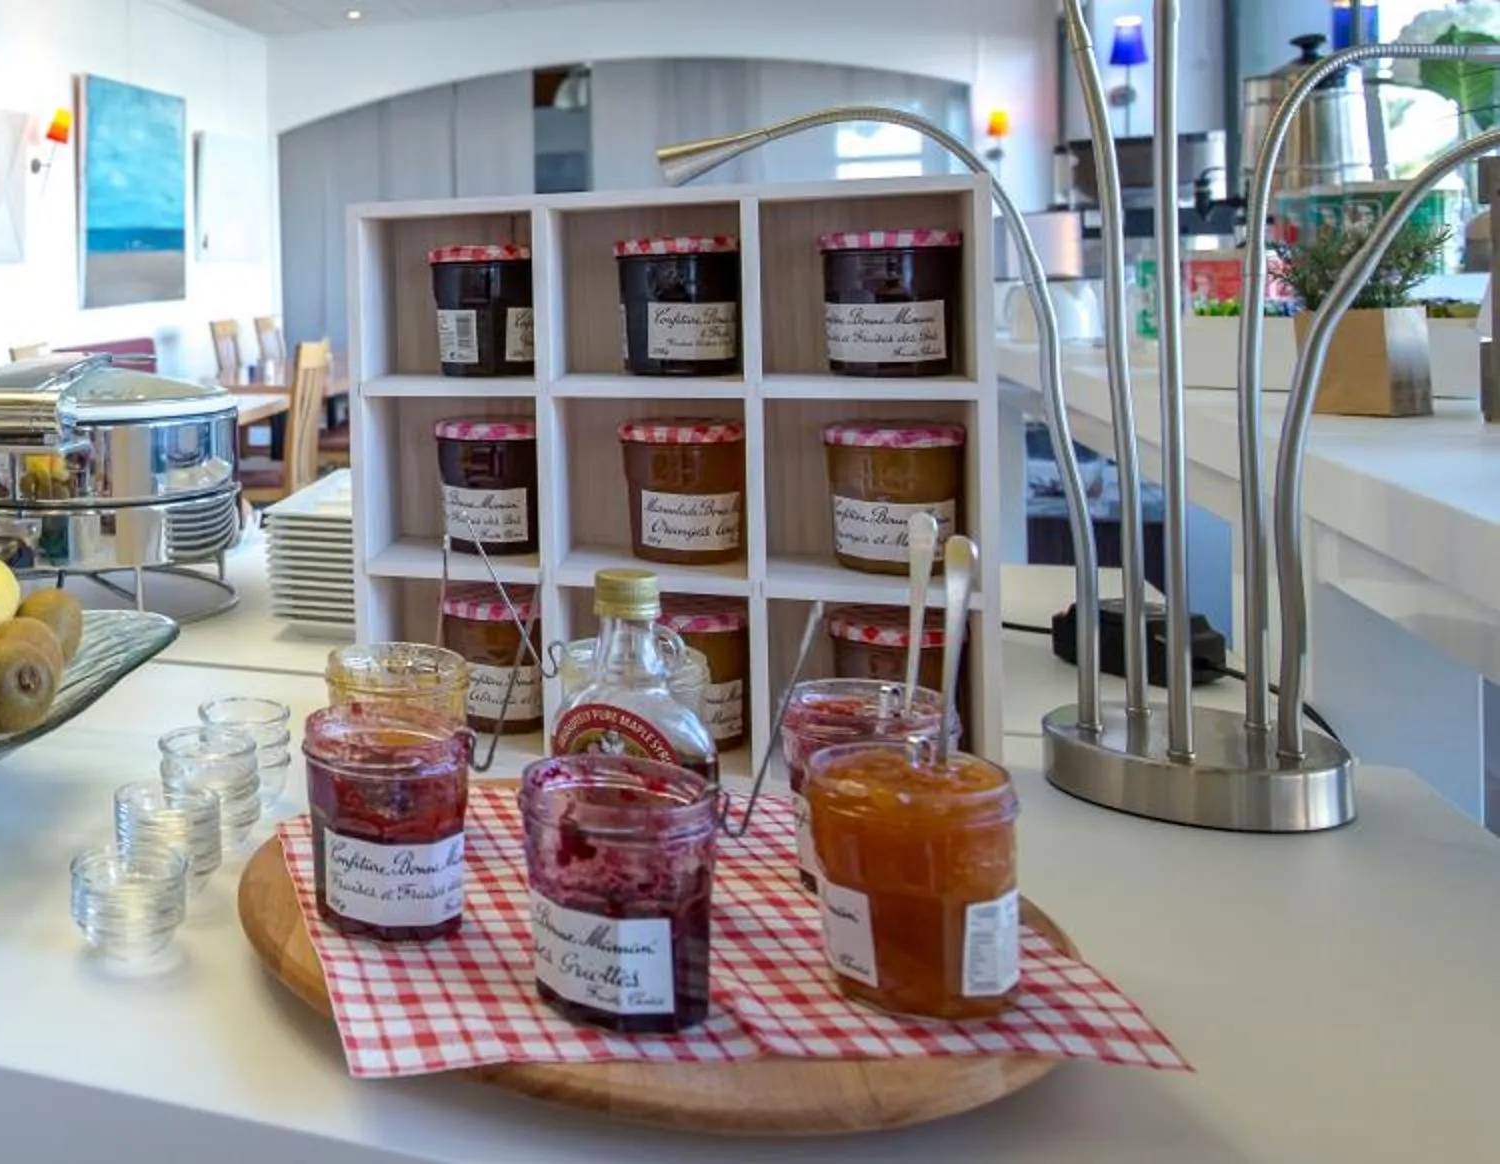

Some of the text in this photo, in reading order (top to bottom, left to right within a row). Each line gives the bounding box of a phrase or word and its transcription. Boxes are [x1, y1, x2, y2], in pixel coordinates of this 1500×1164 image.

[651, 516, 710, 542] Oranges
[618, 714, 652, 742] MAPLE
[329, 838, 387, 877] Confiture
[392, 850, 438, 876] Bonne
[558, 951, 640, 988] Griottes
